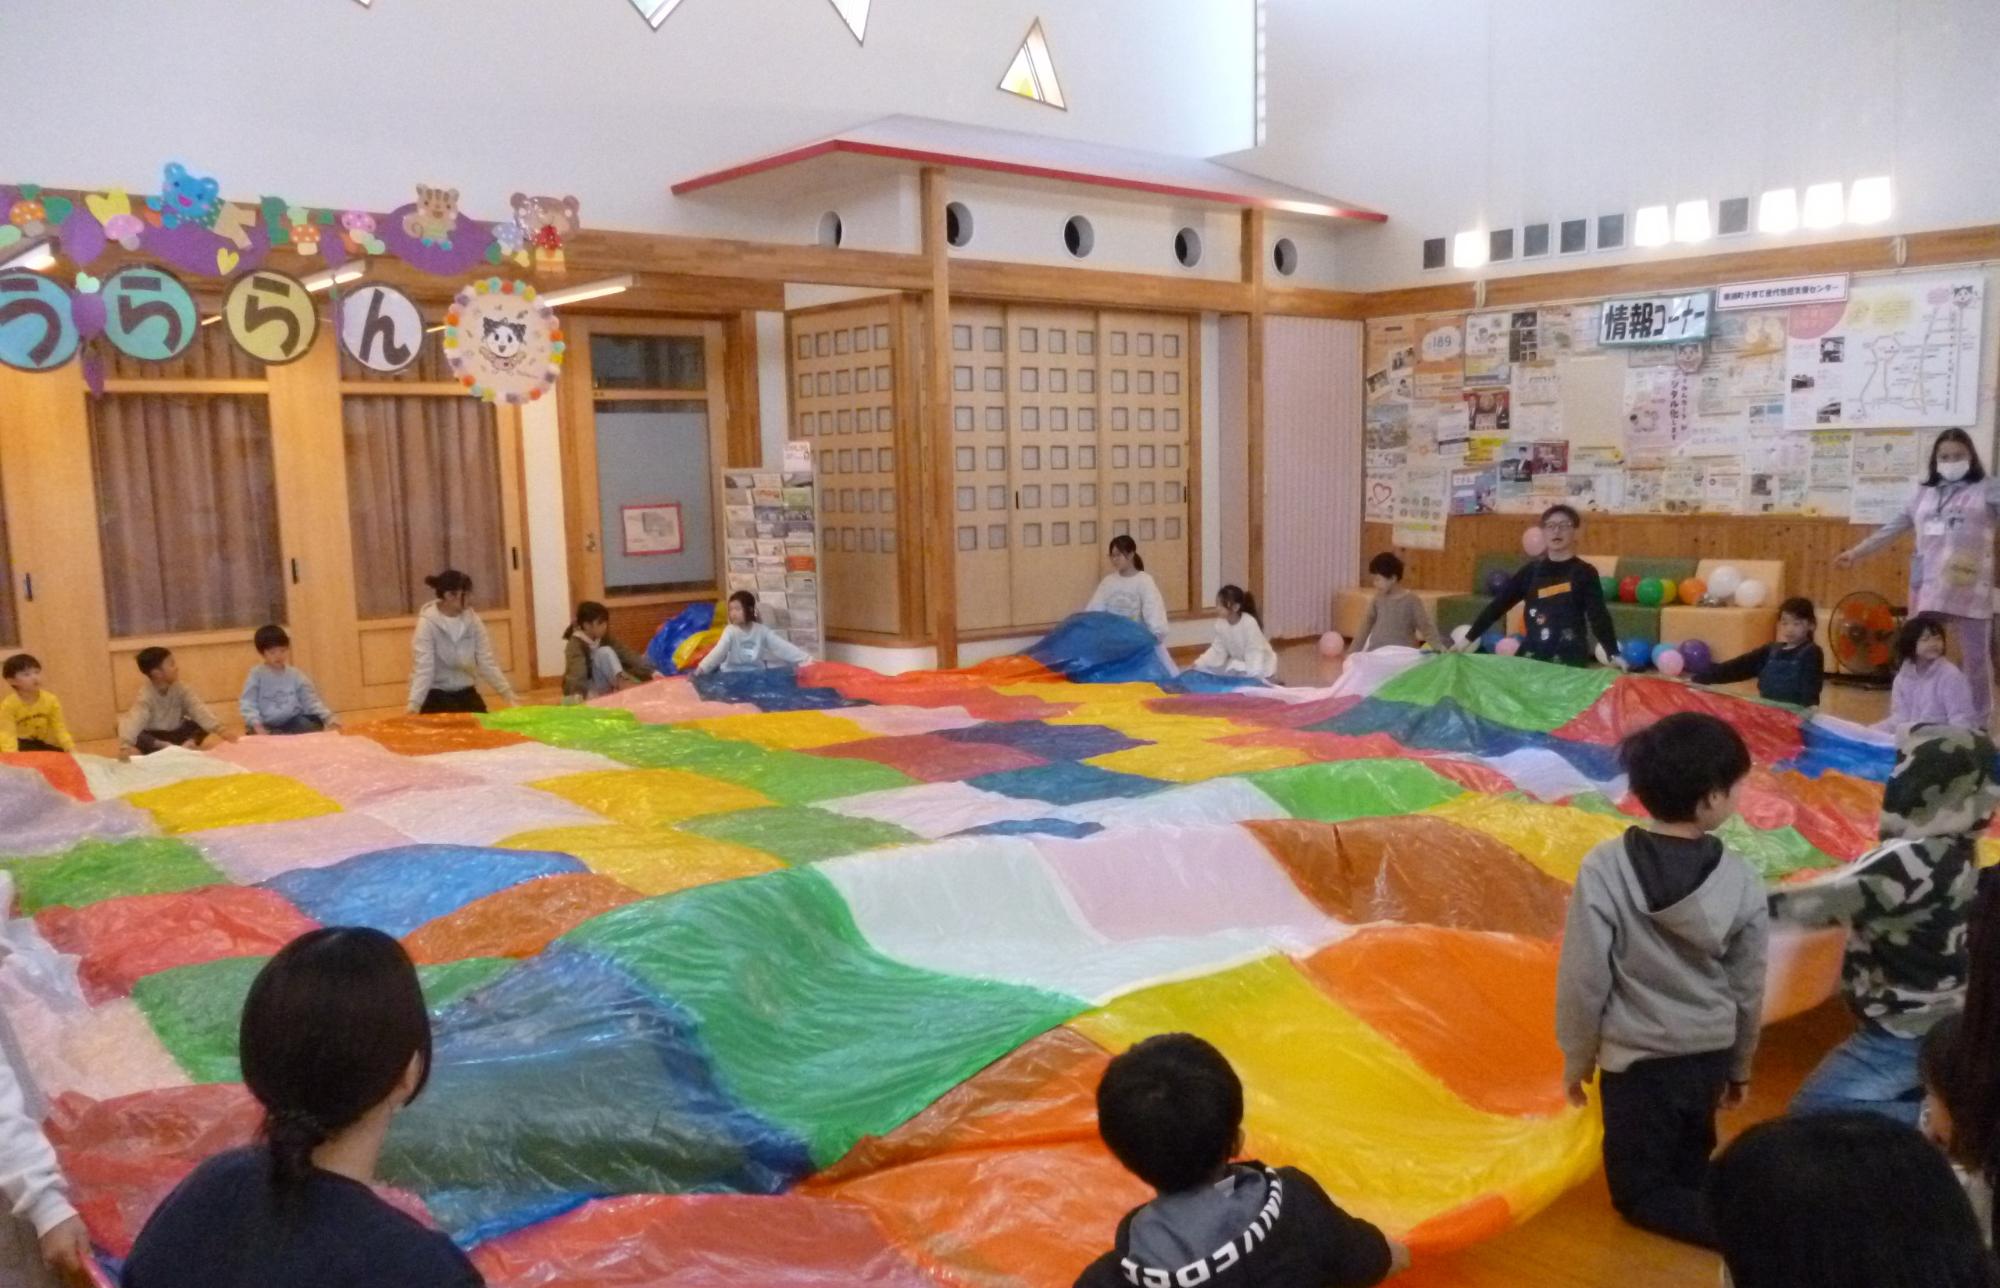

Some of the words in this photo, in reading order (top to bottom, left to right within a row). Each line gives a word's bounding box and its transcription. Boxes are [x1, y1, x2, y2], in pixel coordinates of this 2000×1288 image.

[0, 276, 411, 367] うららん
[1605, 299, 1705, 340] 情報コーナー
[1432, 335, 1452, 348] 189
